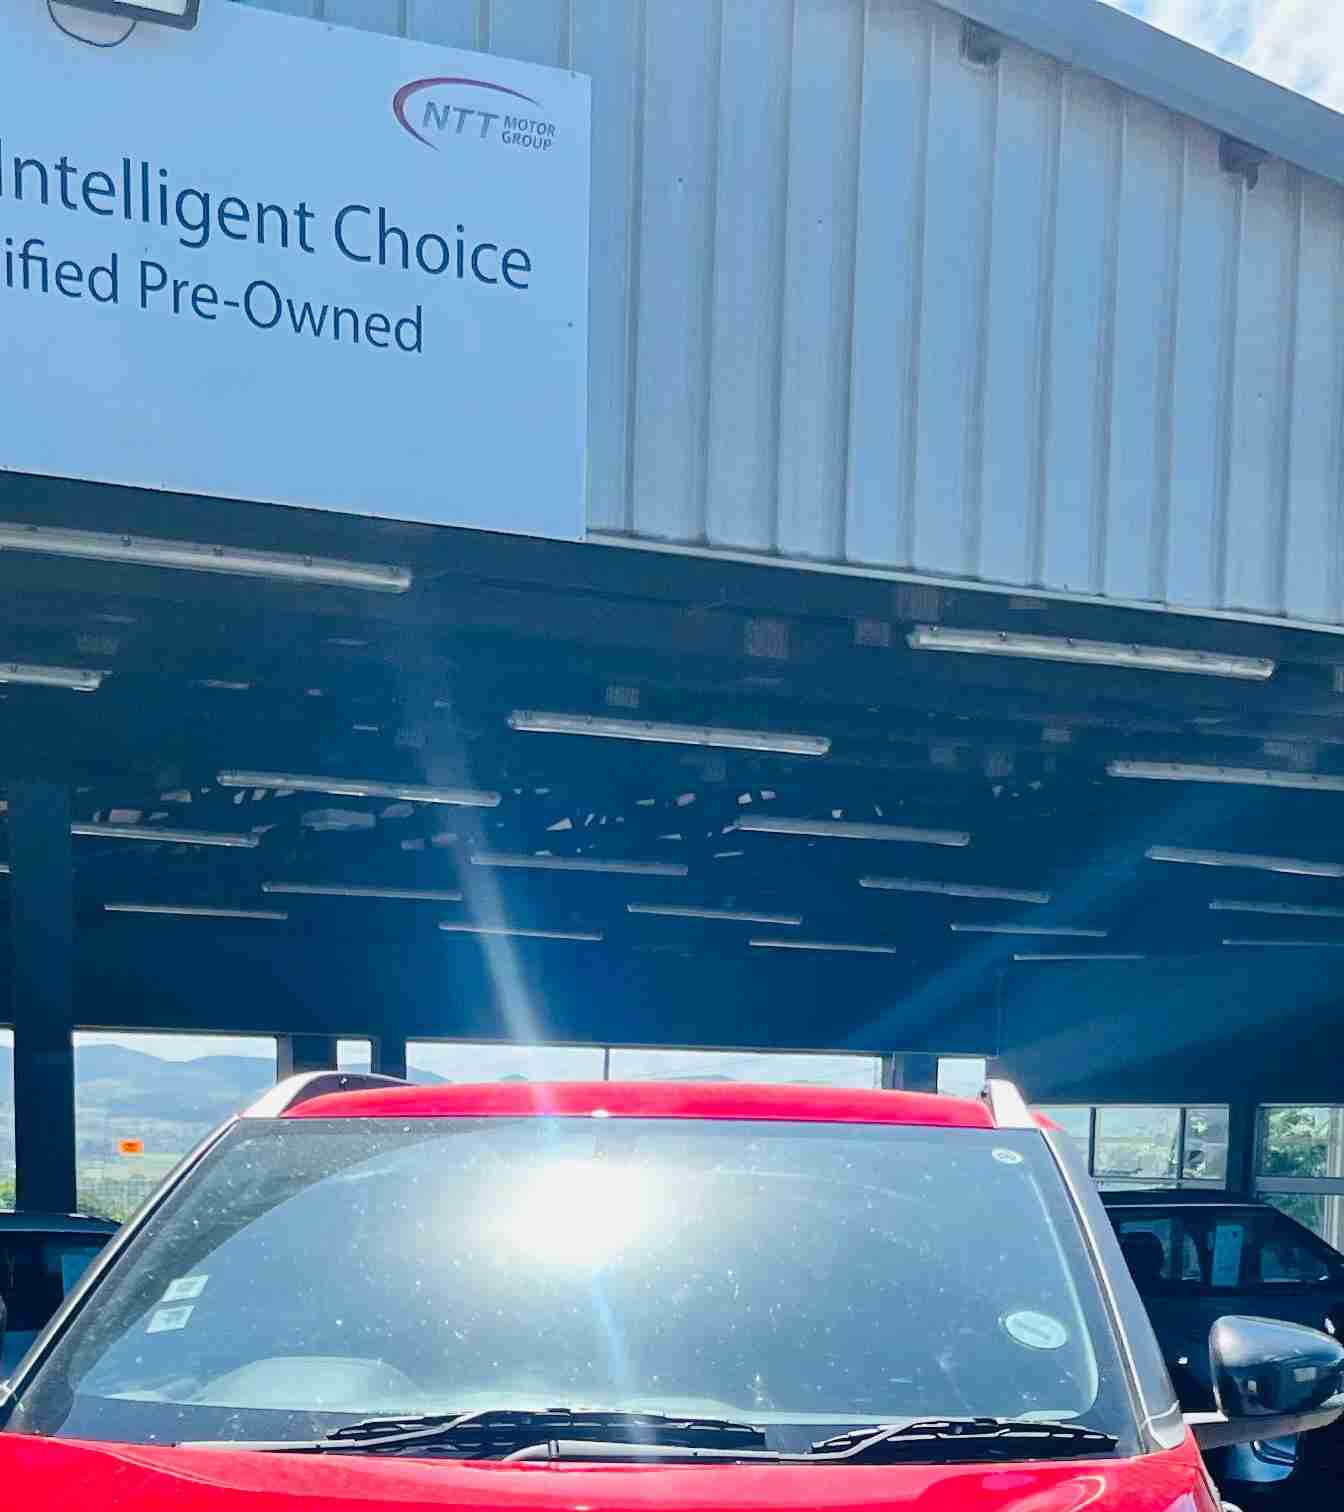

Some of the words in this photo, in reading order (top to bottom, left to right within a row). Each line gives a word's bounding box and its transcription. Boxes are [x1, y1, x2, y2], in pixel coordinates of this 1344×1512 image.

[422, 101, 500, 139] NTT
[503, 115, 556, 137] MOTOR
[501, 130, 553, 151] GROUP
[333, 204, 532, 290] Choice
[139, 260, 423, 353] Pre-Owned
